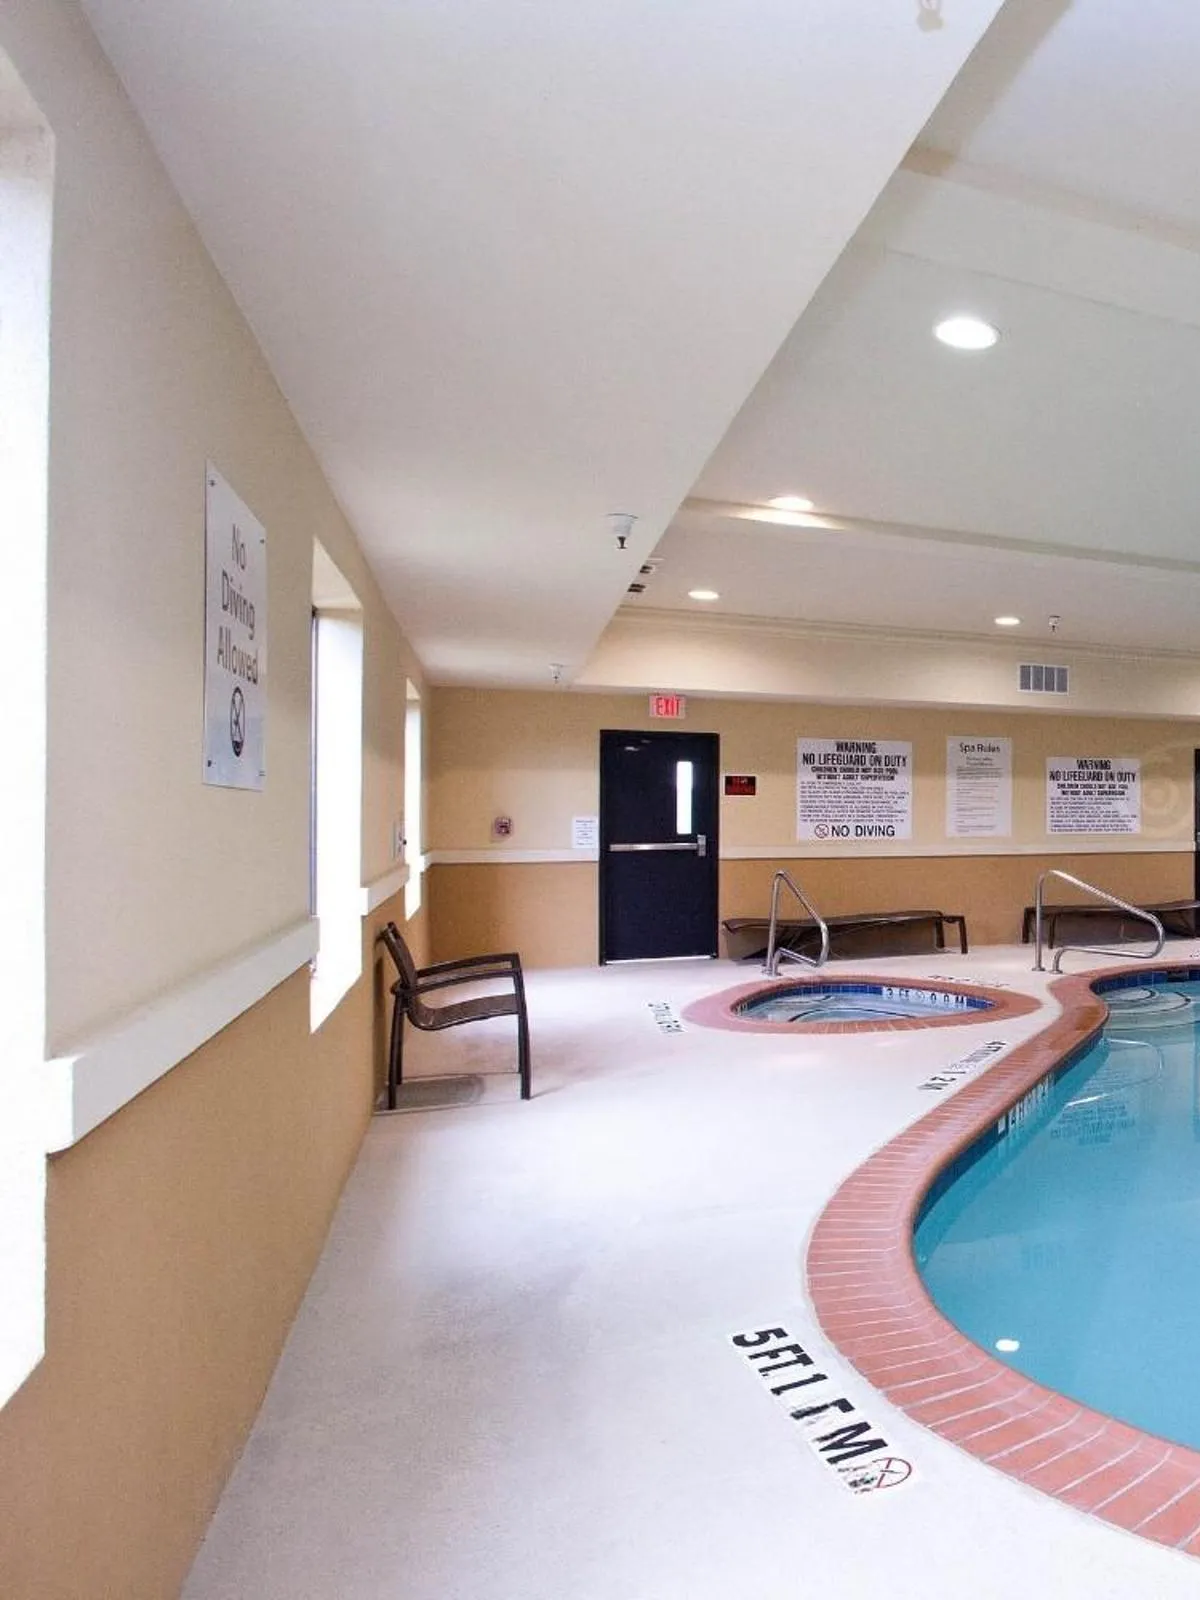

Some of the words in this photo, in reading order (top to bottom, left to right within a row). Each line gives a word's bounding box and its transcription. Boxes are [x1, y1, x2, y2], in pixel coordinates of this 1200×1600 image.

[232, 524, 246, 570] No
[222, 569, 256, 640] Diving
[217, 626, 260, 684] Allowed
[656, 697, 679, 716] EXIT
[835, 742, 876, 754] WARNING
[959, 742, 975, 754] Spa
[802, 753, 815, 766] NO
[818, 753, 866, 767] LIFEGUARD
[870, 755, 882, 767] ON
[884, 755, 908, 767] DUTY
[1049, 771, 1061, 781] NO
[1063, 771, 1103, 781] LIFEGUARD
[1117, 772, 1136, 782] DUTY
[831, 825, 850, 837] NO
[855, 825, 895, 838] DIVING
